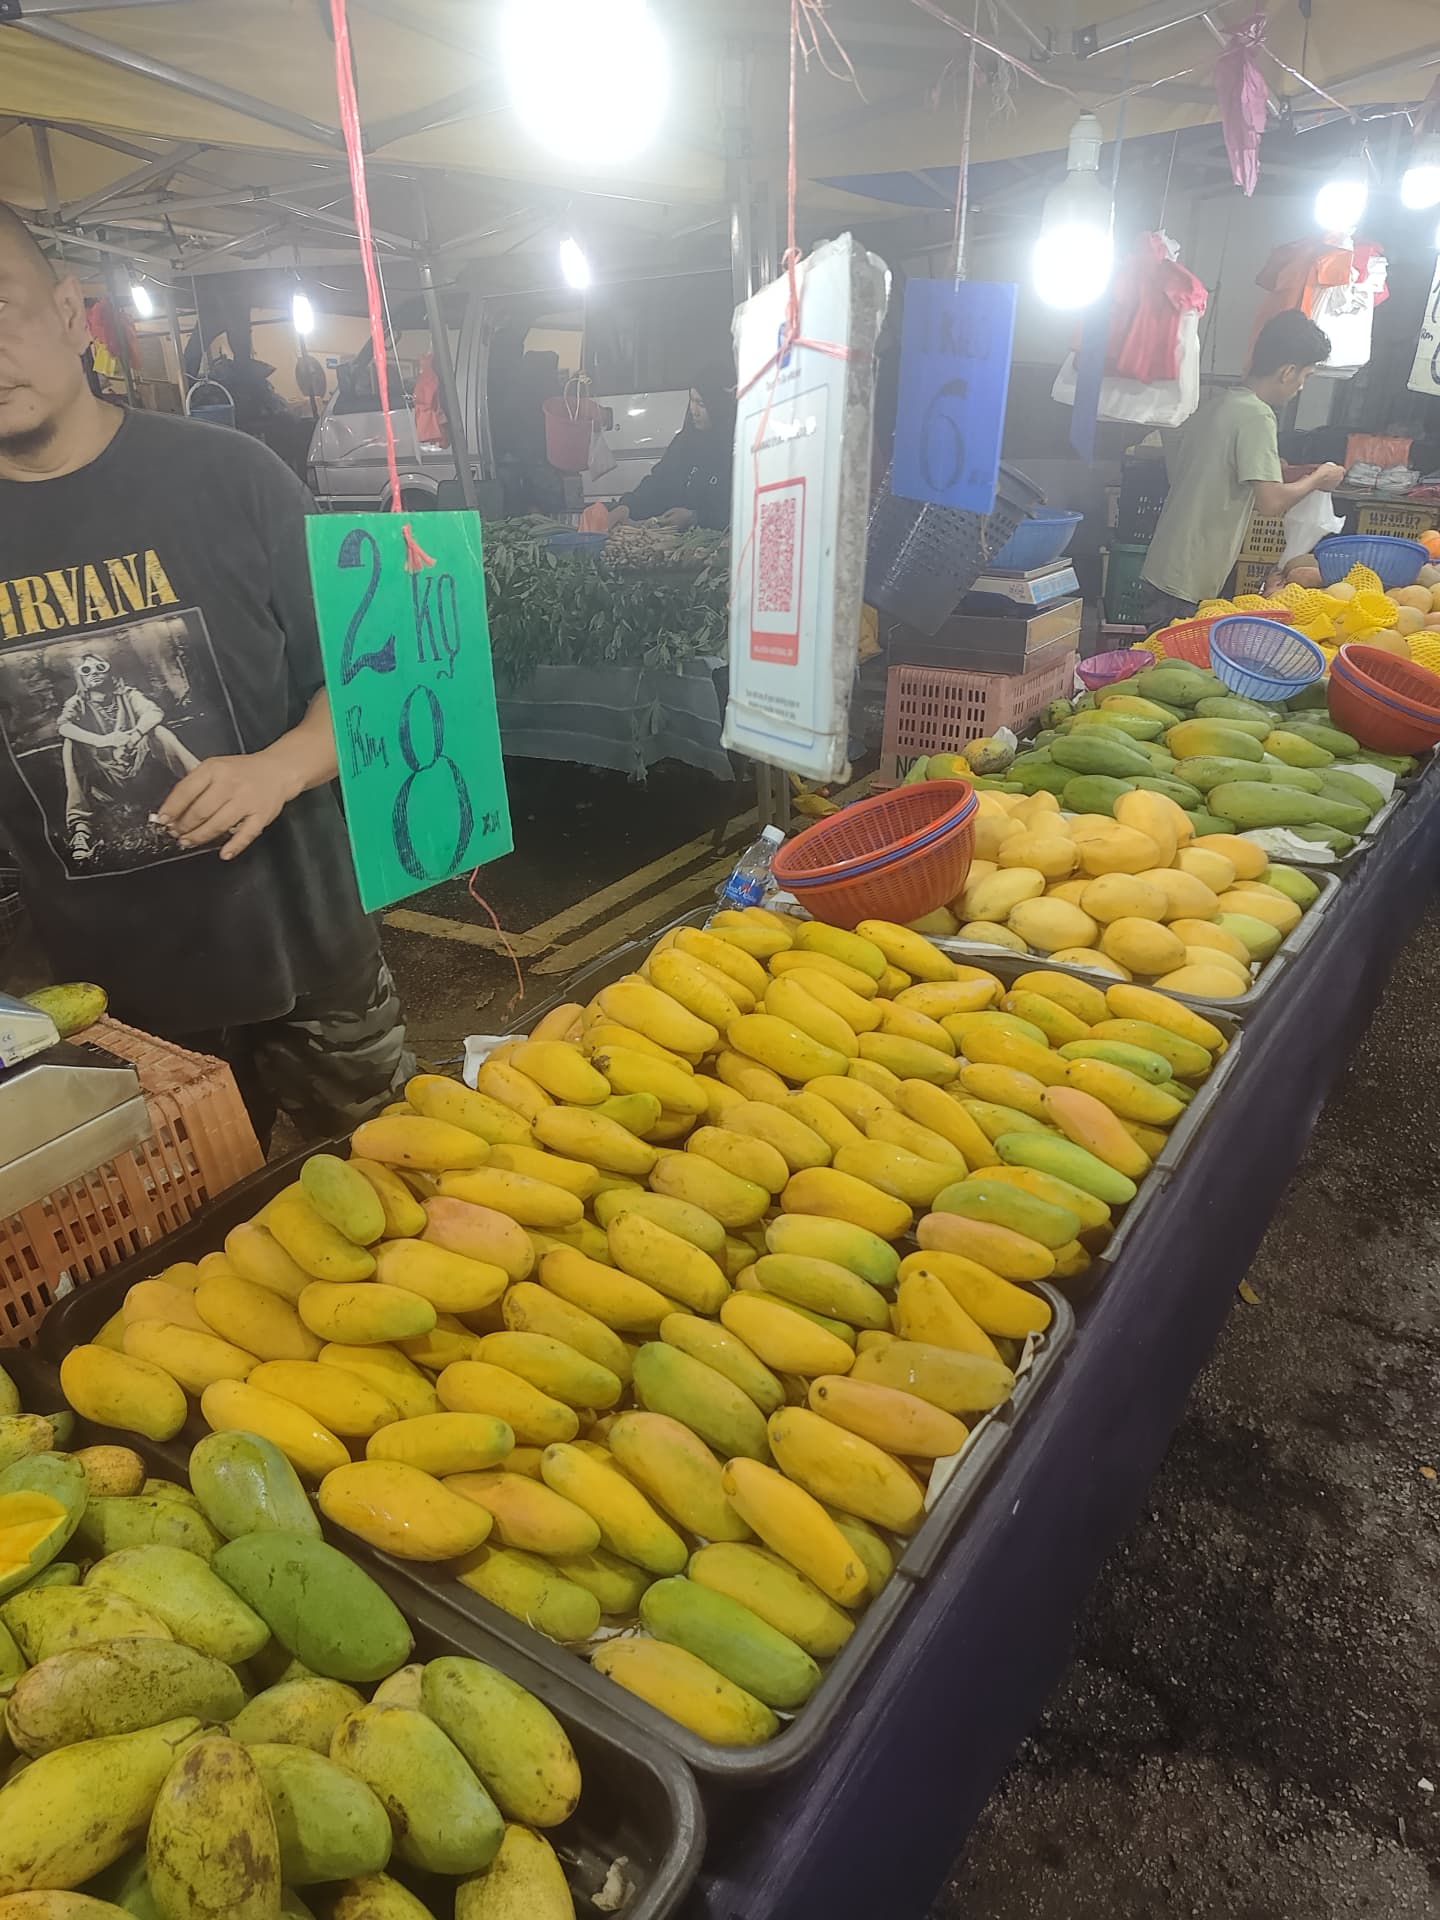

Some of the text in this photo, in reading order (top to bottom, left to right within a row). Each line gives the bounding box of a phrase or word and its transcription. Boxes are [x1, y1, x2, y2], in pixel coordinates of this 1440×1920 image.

[919, 378, 968, 492] 6
[0, 549, 181, 641] IRVANA
[338, 528, 396, 686] 2
[392, 684, 474, 880] 8
